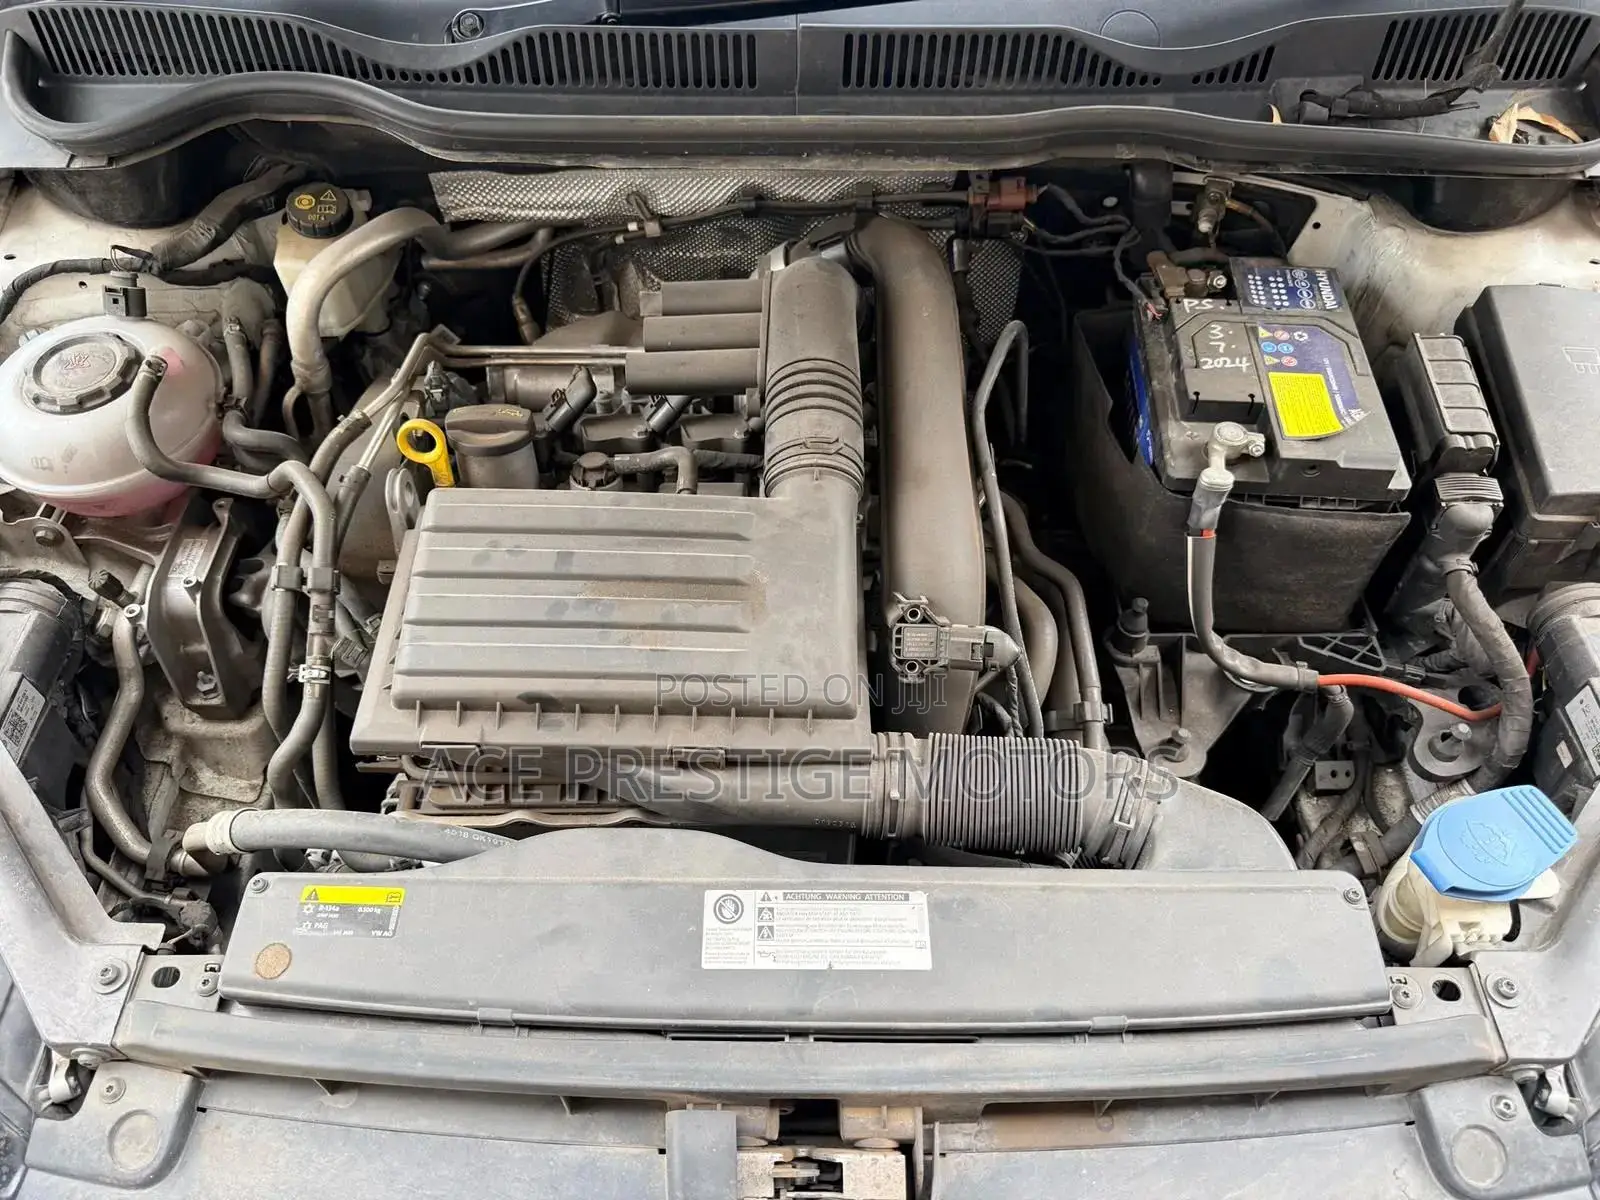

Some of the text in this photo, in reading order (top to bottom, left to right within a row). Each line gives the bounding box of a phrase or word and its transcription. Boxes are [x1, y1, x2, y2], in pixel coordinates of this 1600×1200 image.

[1315, 270, 1338, 310] HYUNDAI
[1200, 357, 1251, 373] 2024
[785, 892, 905, 902] ACHTUNG WARNING ATTENTION
